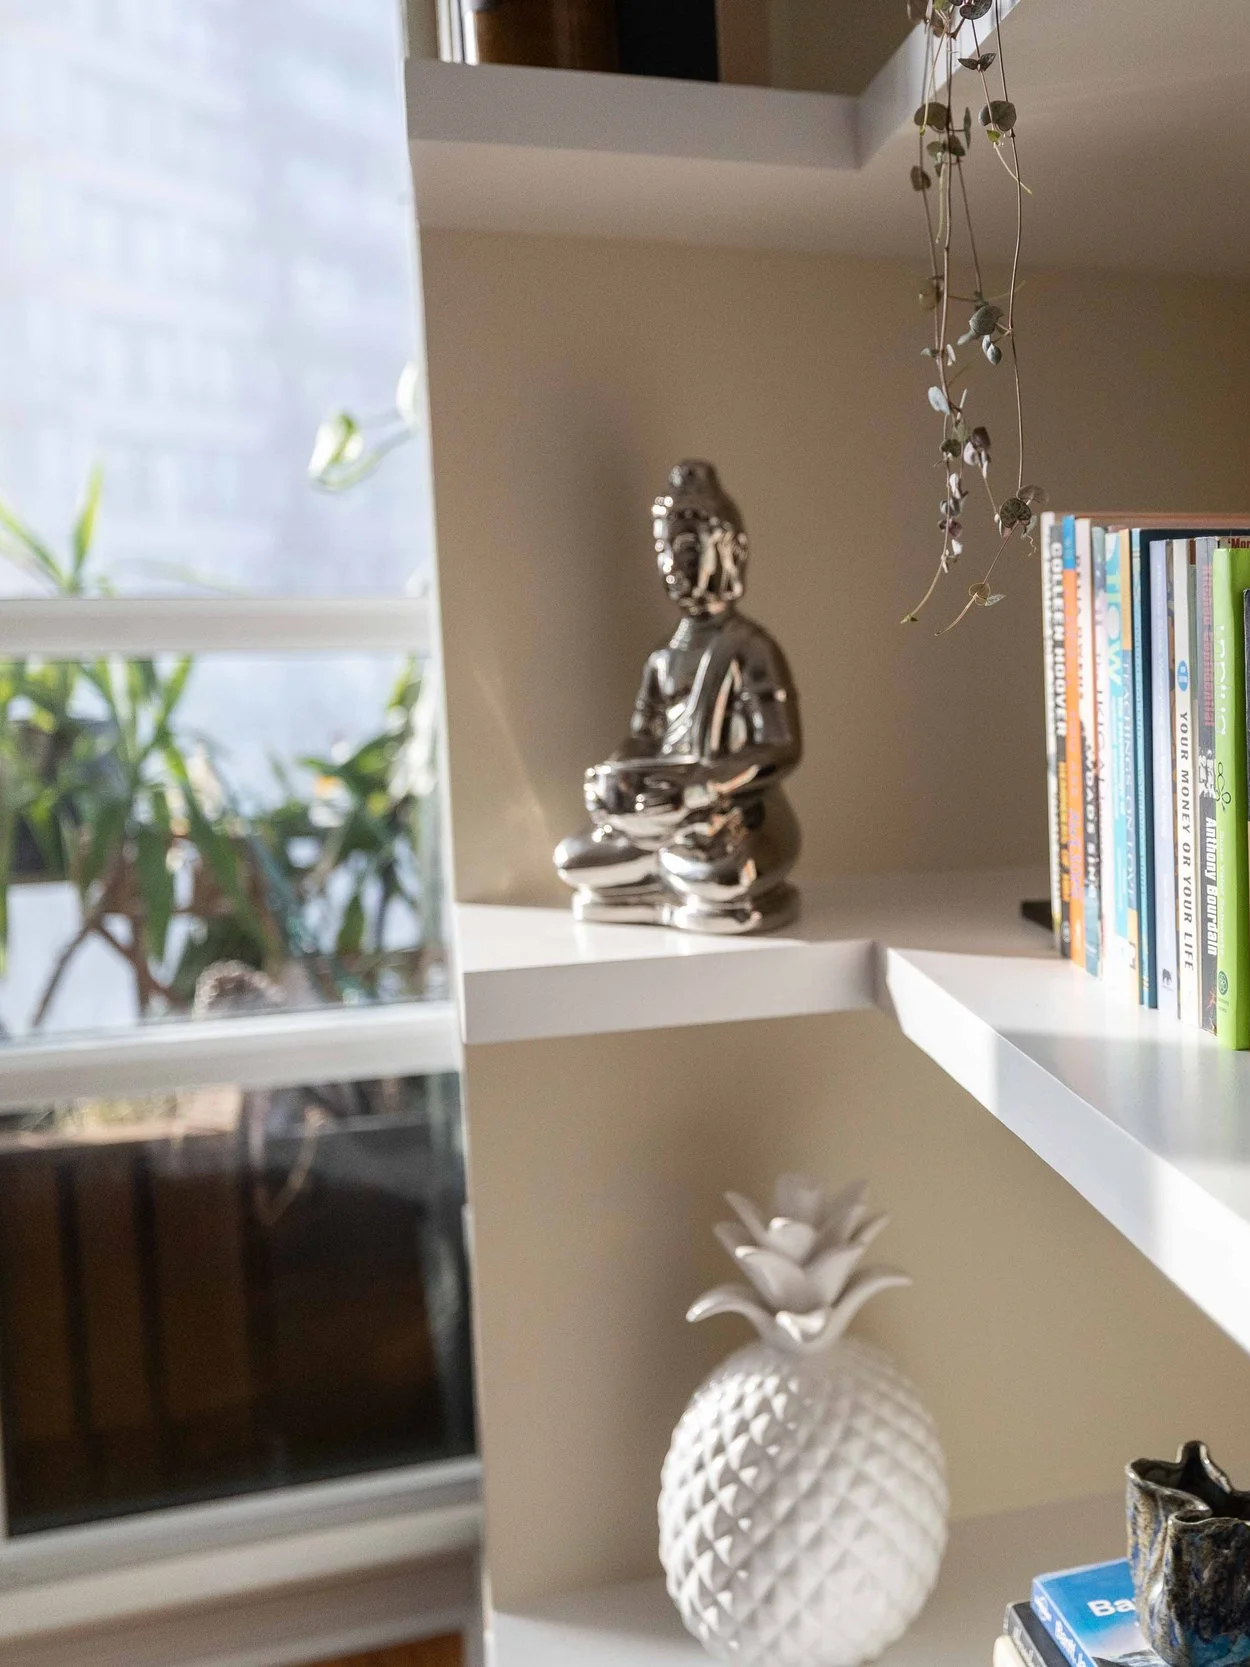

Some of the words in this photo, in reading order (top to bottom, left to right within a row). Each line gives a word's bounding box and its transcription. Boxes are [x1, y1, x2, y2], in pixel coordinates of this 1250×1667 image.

[1051, 541, 1065, 639] COLLEEN
[1055, 646, 1067, 736] HOOVER
[1123, 663, 1131, 785] TEACHINGS
[1180, 710, 1189, 760] YOUR
[1125, 795, 1133, 829] ON
[1181, 769, 1190, 832] MONEY
[1126, 840, 1134, 899] LOVE
[1183, 842, 1191, 866] OR
[1205, 816, 1216, 880] Anthony
[1183, 874, 1192, 923] YOUR
[1206, 884, 1217, 956] Bourdain
[1184, 932, 1194, 970] LIFE
[1087, 1599, 1137, 1617] Ba
